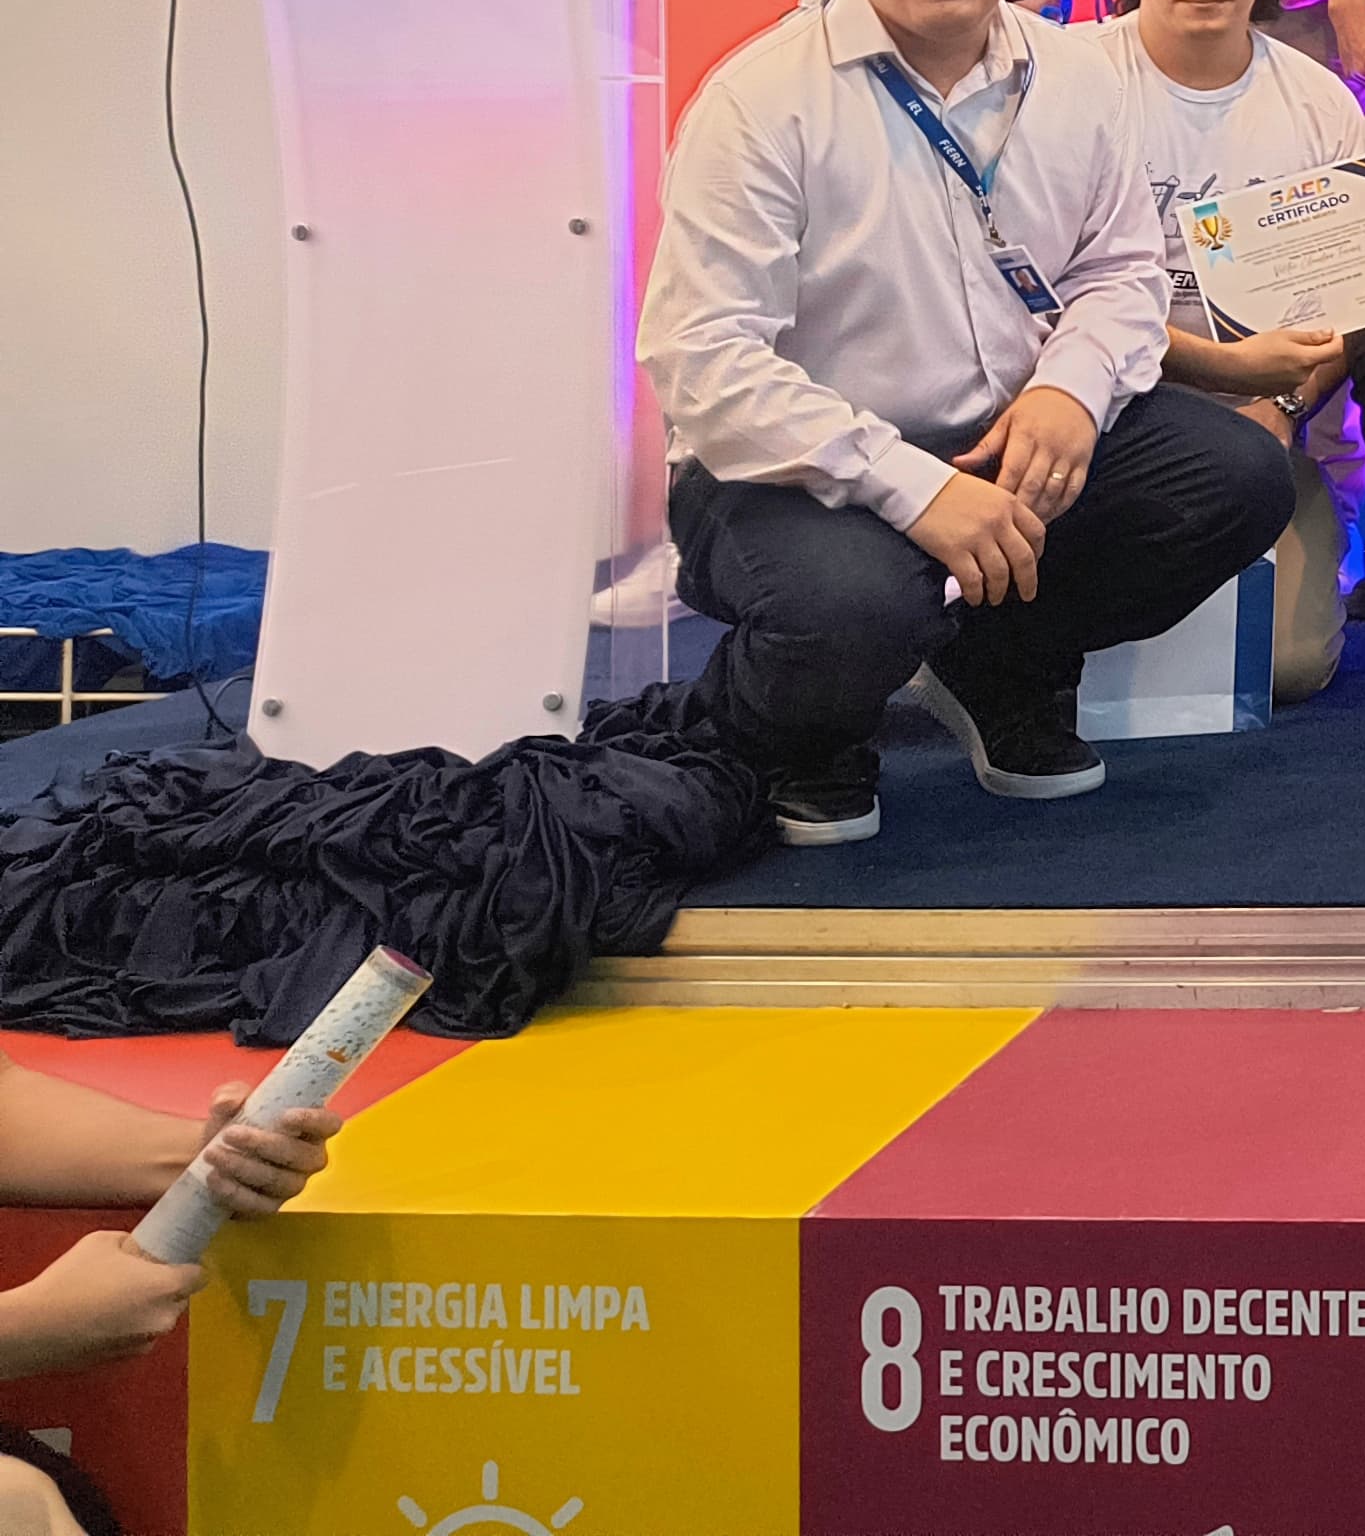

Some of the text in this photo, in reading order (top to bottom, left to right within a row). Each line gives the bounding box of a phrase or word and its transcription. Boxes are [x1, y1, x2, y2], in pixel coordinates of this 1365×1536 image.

[1257, 193, 1350, 228] CERTIFICADO
[1269, 177, 1331, 208] SAEP
[323, 1281, 651, 1332] ENERGIA LIMPA
[939, 1285, 1170, 1333] TRABALHO
[247, 1279, 308, 1423] 7
[323, 1339, 580, 1395] E ACESSÍVEL
[861, 1286, 922, 1432] 8
[940, 1350, 1272, 1402] E CRESCIMENTO
[939, 1406, 1191, 1464] ECONÔMICO
